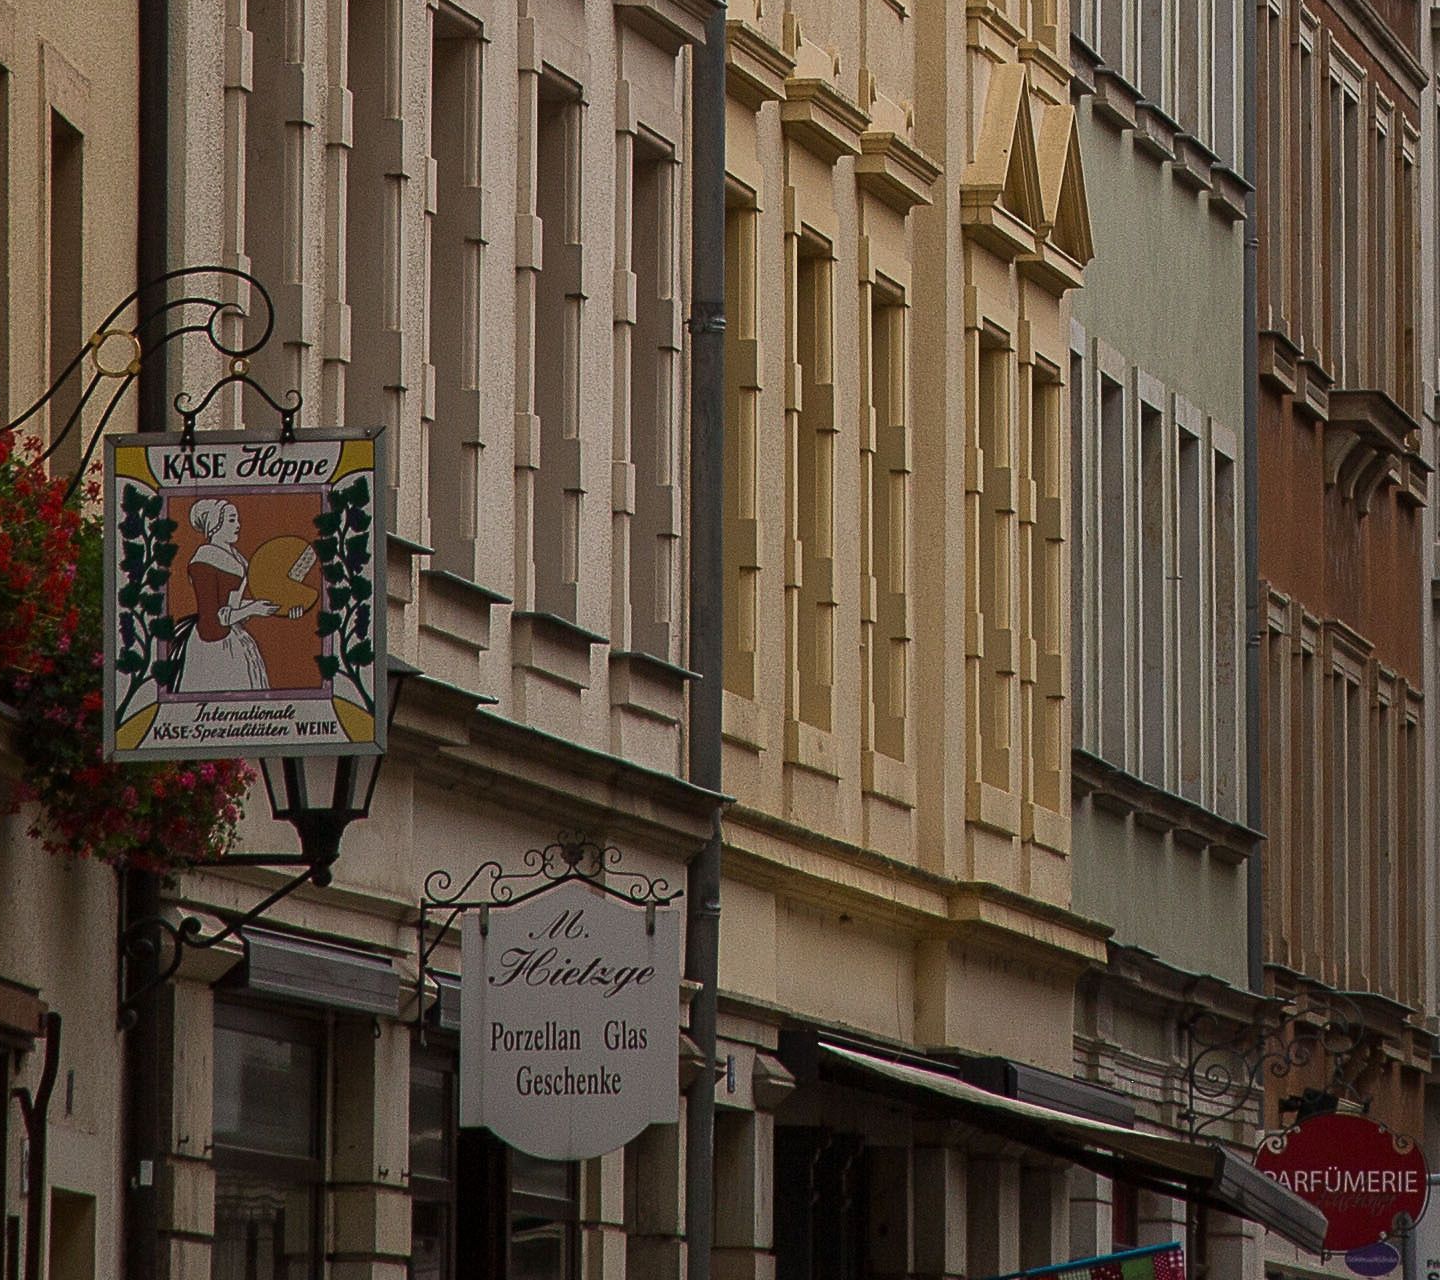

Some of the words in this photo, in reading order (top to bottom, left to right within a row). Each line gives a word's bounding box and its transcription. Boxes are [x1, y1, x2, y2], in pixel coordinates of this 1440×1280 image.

[162, 445, 227, 484] KÄSE
[236, 443, 329, 484] Hoppe
[193, 703, 296, 723] Internationale
[153, 722, 290, 743] KÄSE-Spezialitäten
[295, 720, 337, 736] WEINE
[528, 909, 590, 940] M.
[488, 947, 656, 999] Hietzge
[490, 1019, 582, 1052] Porzellan
[603, 1019, 648, 1051] Glas
[515, 1063, 622, 1097] Geschenke
